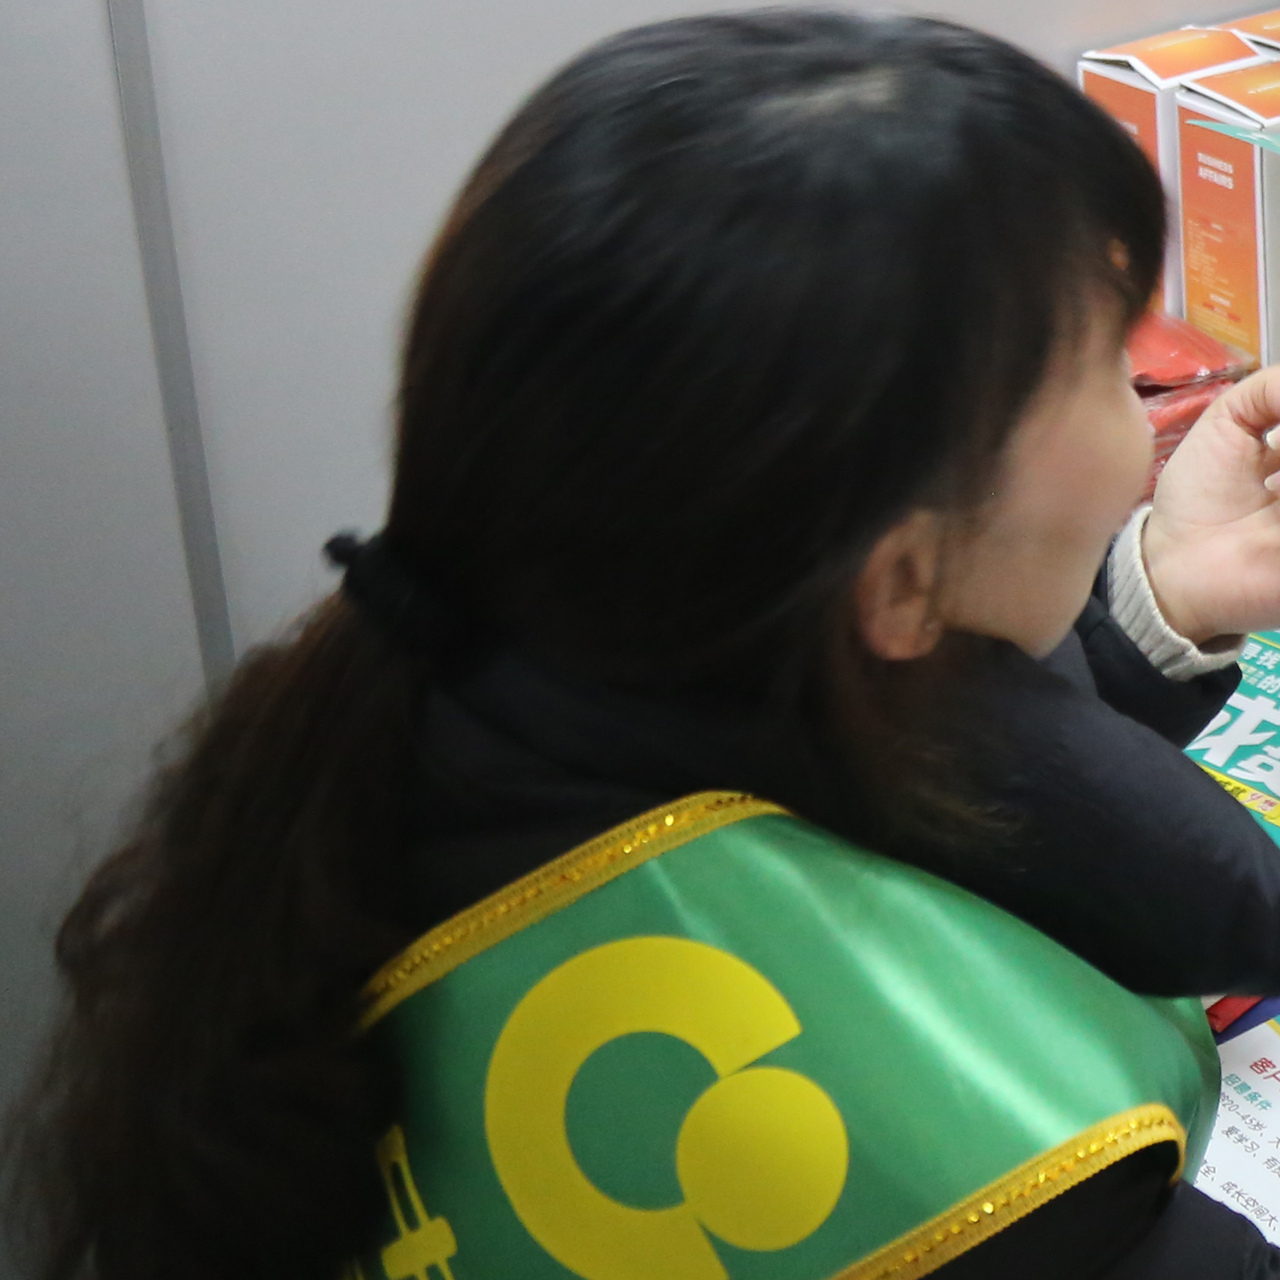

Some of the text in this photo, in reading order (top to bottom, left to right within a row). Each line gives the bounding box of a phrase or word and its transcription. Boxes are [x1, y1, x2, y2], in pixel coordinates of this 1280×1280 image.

[1197, 166, 1235, 189] AFFAIRS
[1221, 1073, 1273, 1112] 招聘条件
